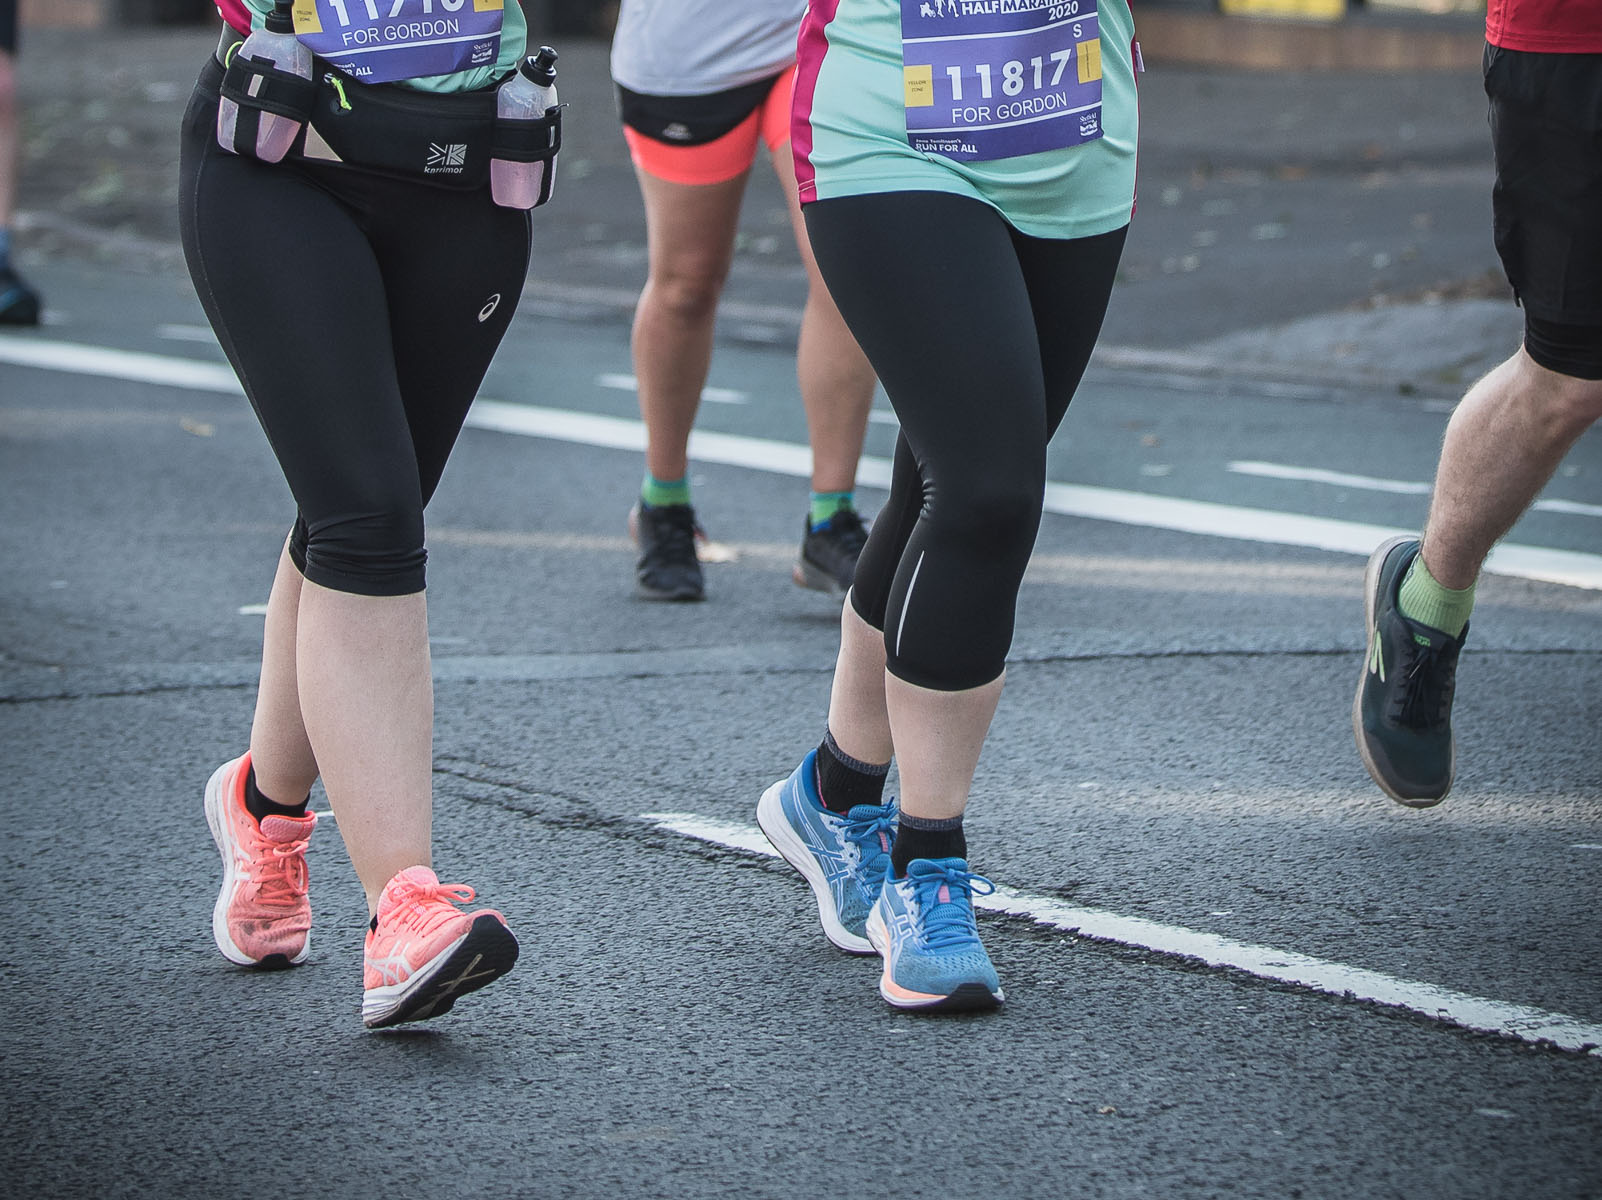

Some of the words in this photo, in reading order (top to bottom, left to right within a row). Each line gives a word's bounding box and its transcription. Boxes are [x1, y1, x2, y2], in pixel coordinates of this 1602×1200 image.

[961, 2, 1000, 16] HALF
[1048, 1, 1079, 21] 2020
[342, 28, 381, 46] FOR
[384, 19, 460, 43] GORDON
[1072, 23, 1083, 38] S
[356, 66, 373, 76] ALL
[946, 48, 1072, 101] 11817
[951, 106, 992, 124] FOR
[996, 91, 1068, 120] GORDON
[915, 143, 937, 152] RUN
[939, 144, 959, 152] FOR
[960, 143, 978, 153] ALL
